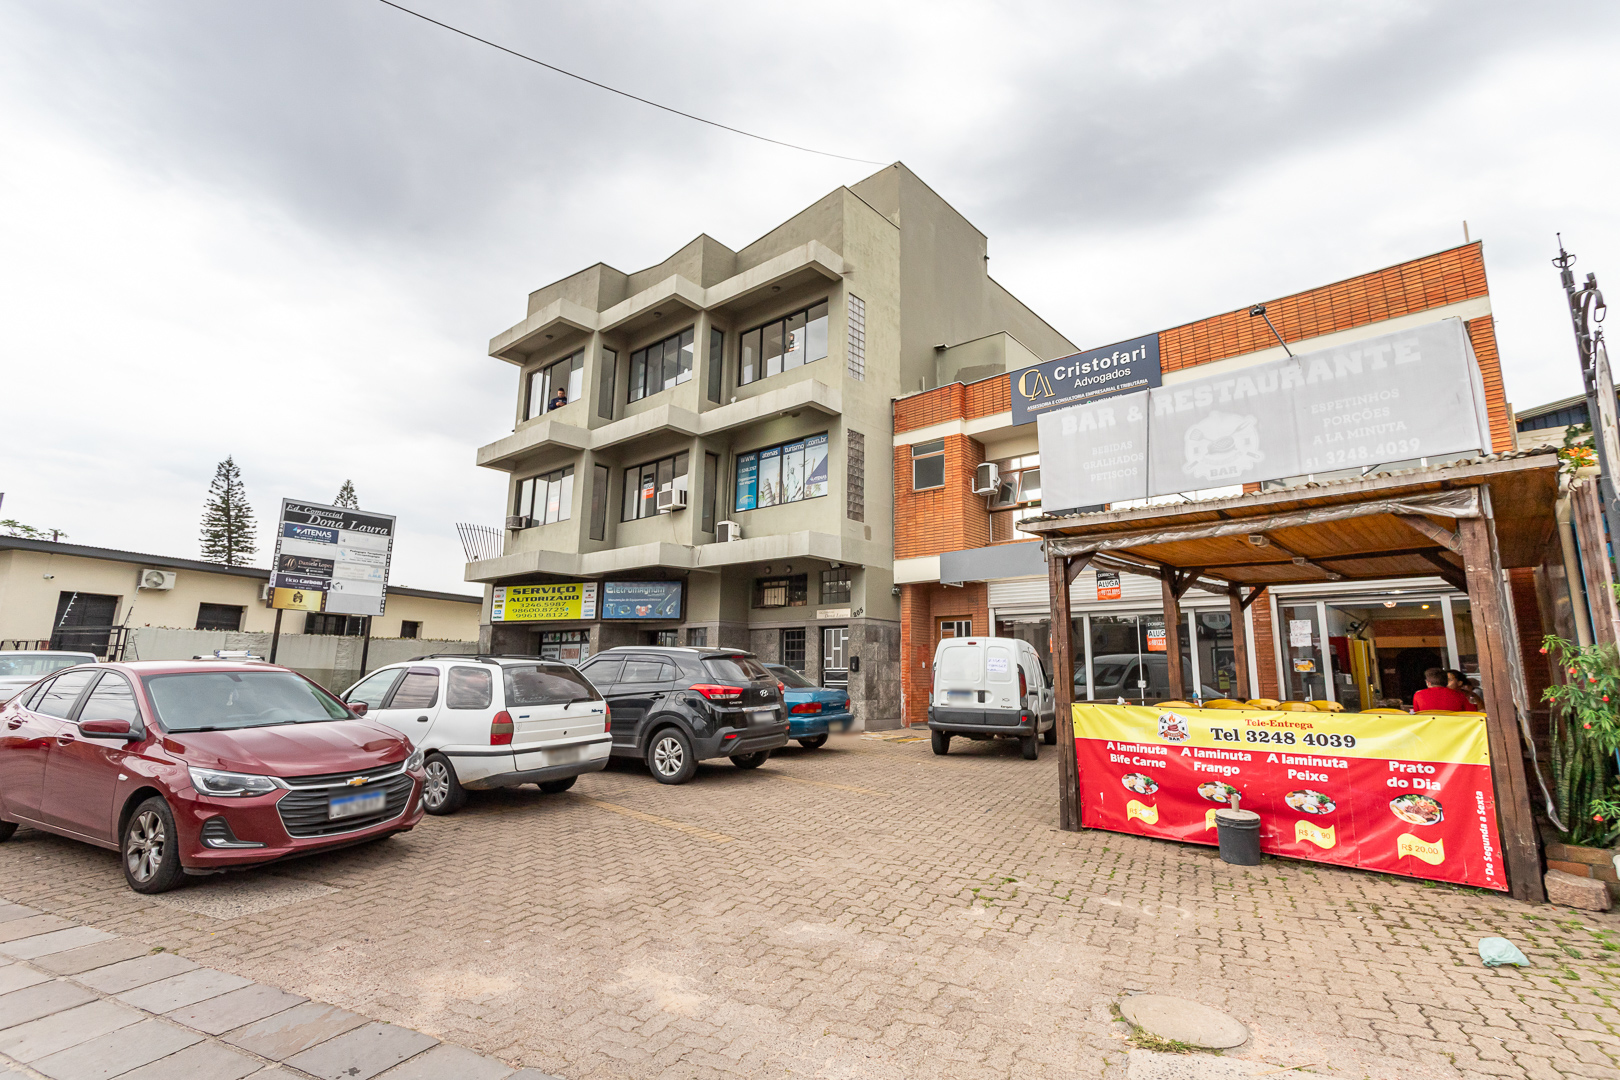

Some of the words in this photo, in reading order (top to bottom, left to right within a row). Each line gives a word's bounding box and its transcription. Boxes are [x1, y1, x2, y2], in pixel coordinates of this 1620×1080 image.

[1053, 345, 1146, 381] Cristofari
[1074, 368, 1131, 388] Advogados
[1061, 405, 1117, 436] BAR
[1126, 404, 1143, 422] &
[1153, 337, 1421, 416] RESTAURANTE
[1085, 386, 1116, 397] EMPRESARIAL
[1120, 378, 1148, 389] TRIBUTÁRIA
[1310, 388, 1400, 414] ESPETINHOS
[1323, 406, 1390, 427] PORÇÕES
[1312, 435, 1323, 446] A
[1326, 431, 1344, 443] LA
[1347, 420, 1407, 440] MINUTA
[1092, 441, 1133, 455] BEBIDAS
[1306, 457, 1319, 468] 51
[1326, 437, 1420, 465] 3248.4039
[1083, 452, 1144, 470] GRALHADOS
[1091, 467, 1138, 482] PETISCOS
[1210, 466, 1238, 477] BAR
[306, 515, 344, 529] Dona
[348, 520, 388, 535] Laura
[300, 528, 332, 538] ATENAS
[512, 586, 577, 595] SERVIÇO
[509, 595, 580, 603] AUTORIZADO
[853, 607, 864, 617] 205
[1244, 718, 1314, 730] Tele-Entrega
[1210, 728, 1240, 742] Tel
[1246, 730, 1296, 746] 3248
[1302, 733, 1356, 749] 4039
[1106, 742, 1115, 751] A
[1116, 742, 1168, 756] laminuta
[1181, 747, 1191, 757] A
[1194, 748, 1252, 762] laminuta
[1110, 754, 1131, 765] Bife
[1132, 756, 1166, 768] Carne
[1267, 753, 1279, 764] A
[1282, 754, 1348, 769] laminuta
[1389, 761, 1436, 774] Prato
[1194, 761, 1240, 777] Frango
[1287, 769, 1329, 782] Peixe
[1386, 776, 1409, 788] do
[1413, 778, 1441, 791] Dia
[1475, 791, 1485, 817] Sexta
[1298, 829, 1309, 837] R$
[1401, 843, 1414, 853] R$
[1478, 824, 1494, 861] Segunda
[1485, 863, 1494, 876] De
